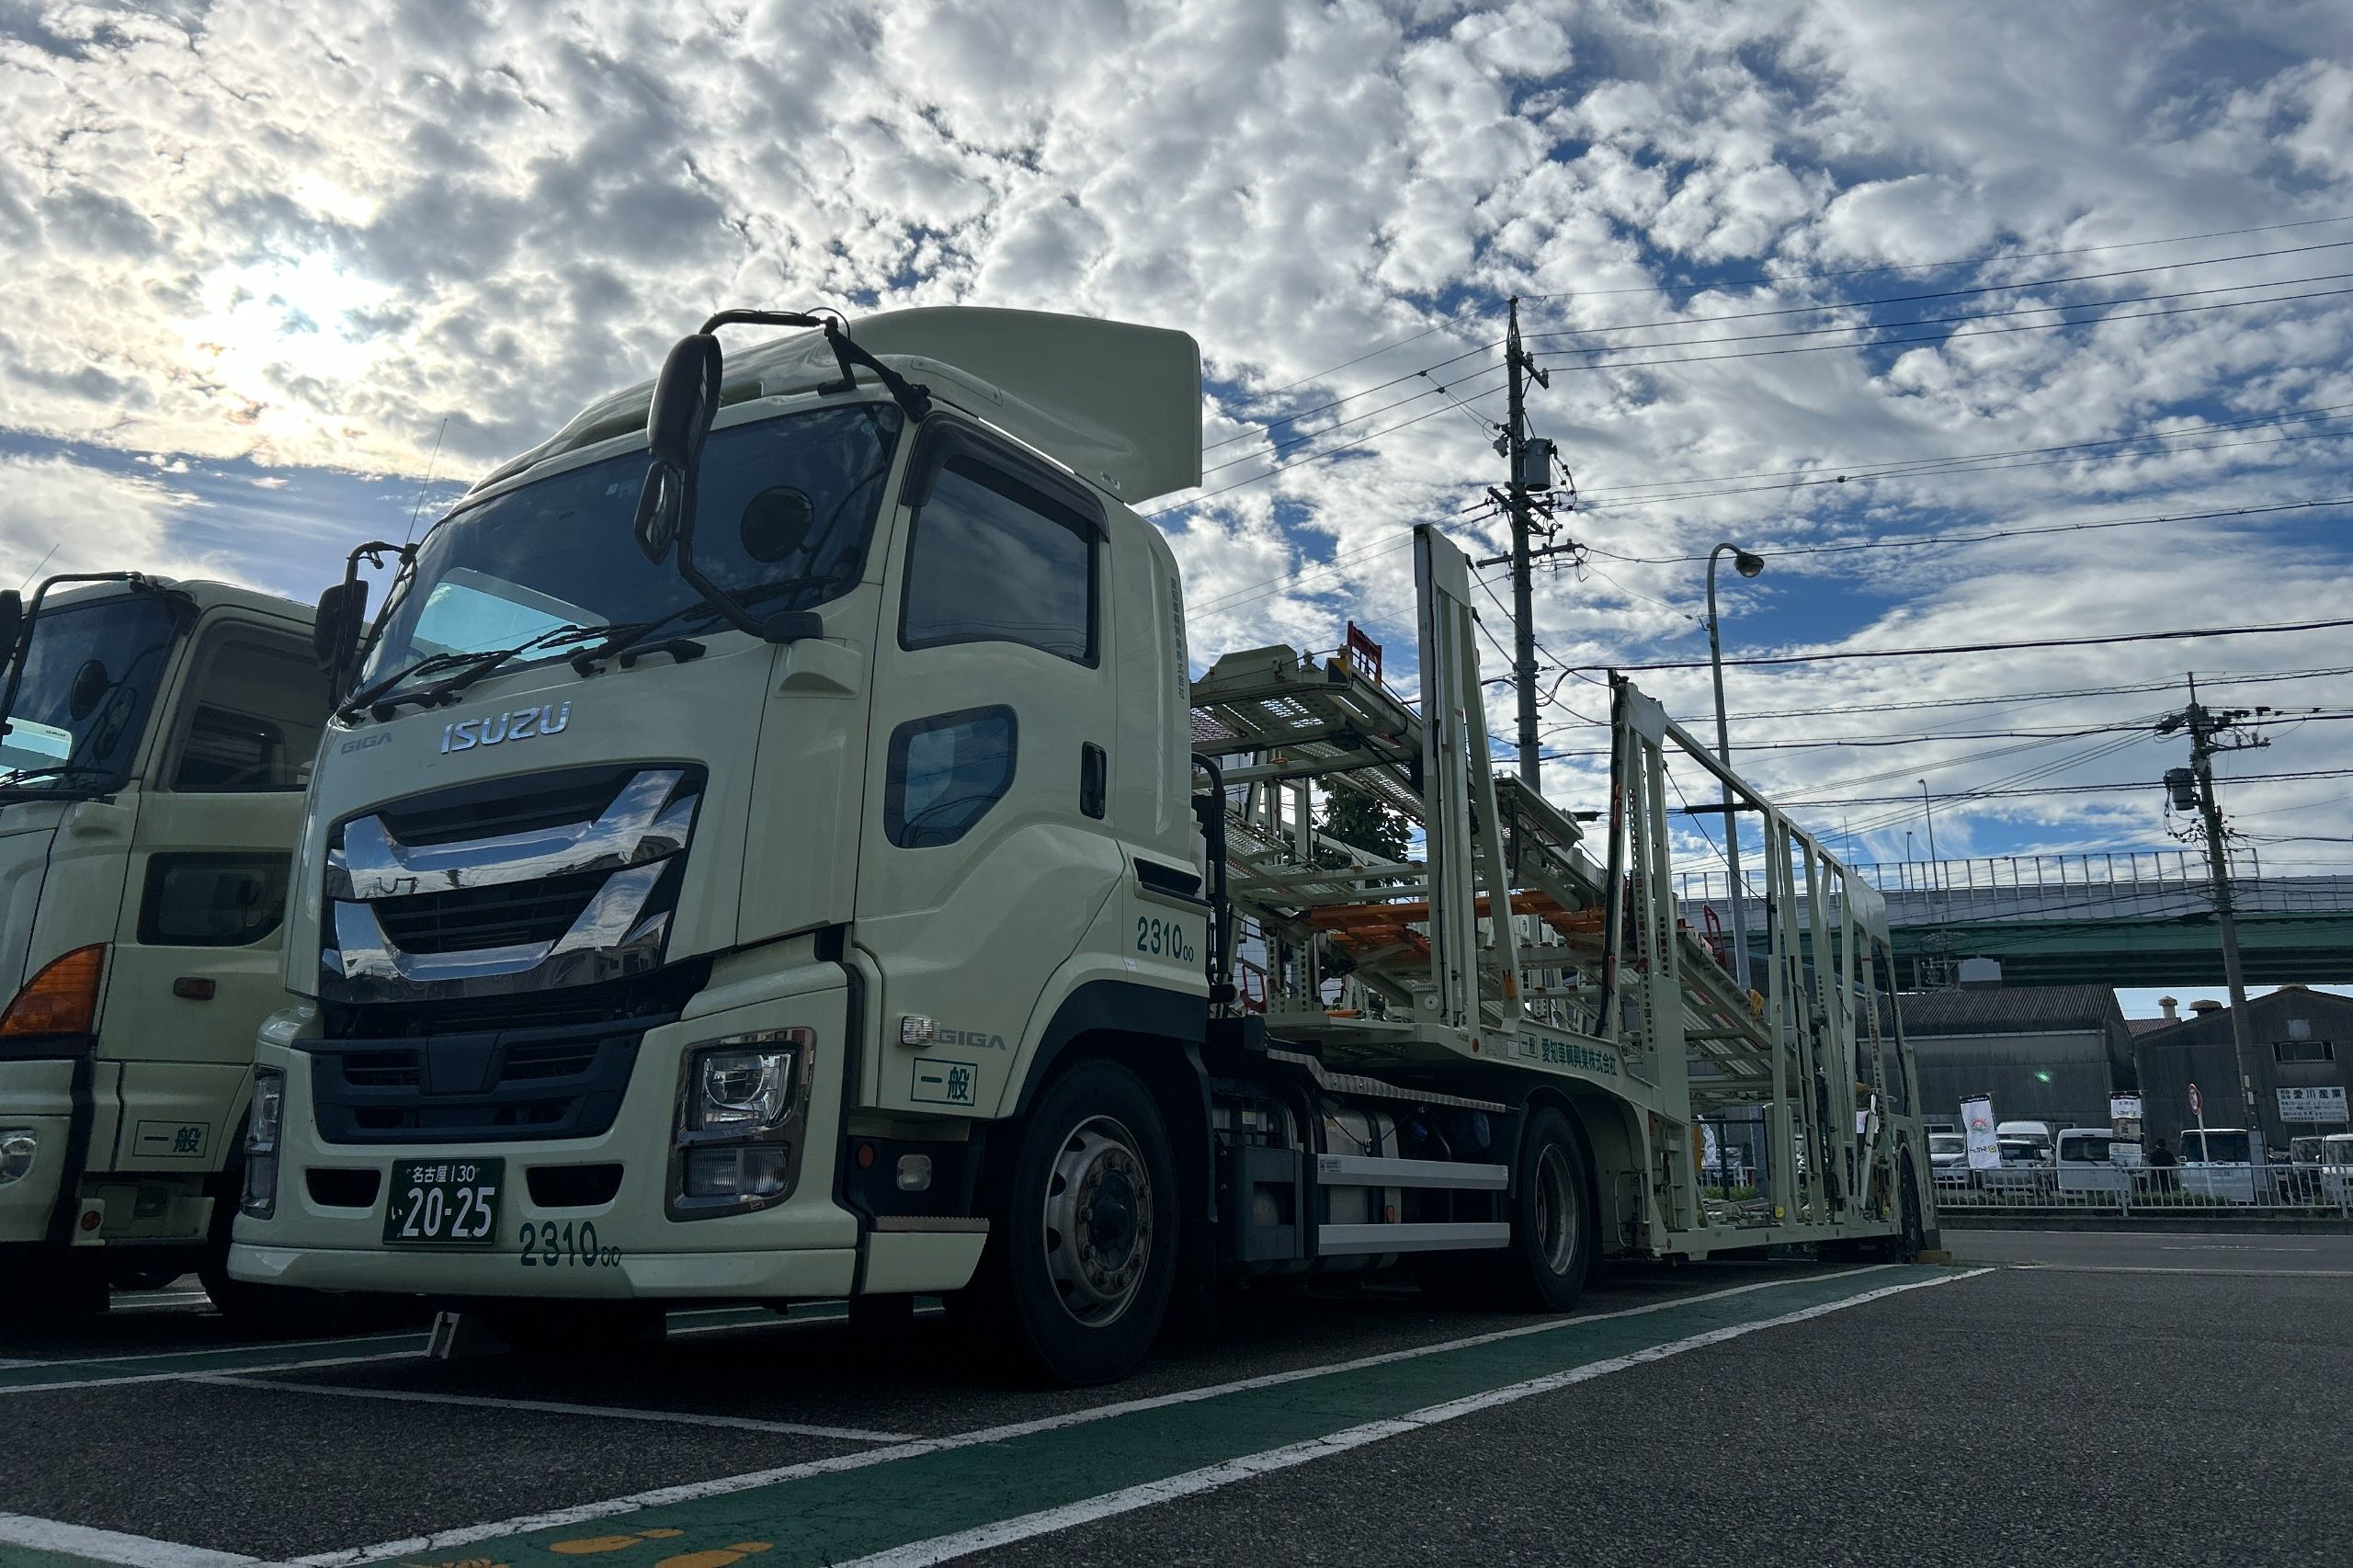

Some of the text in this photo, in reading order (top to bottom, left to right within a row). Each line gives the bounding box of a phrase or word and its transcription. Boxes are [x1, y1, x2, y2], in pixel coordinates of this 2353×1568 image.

[440, 700, 572, 755] ISUZU
[340, 731, 392, 756] GIGA
[938, 1028, 1006, 1051] GIGA
[1521, 1036, 1536, 1054] 一般
[921, 1066, 971, 1101] 一般
[144, 1127, 201, 1153] 一般
[391, 1187, 495, 1237] い 20-25
